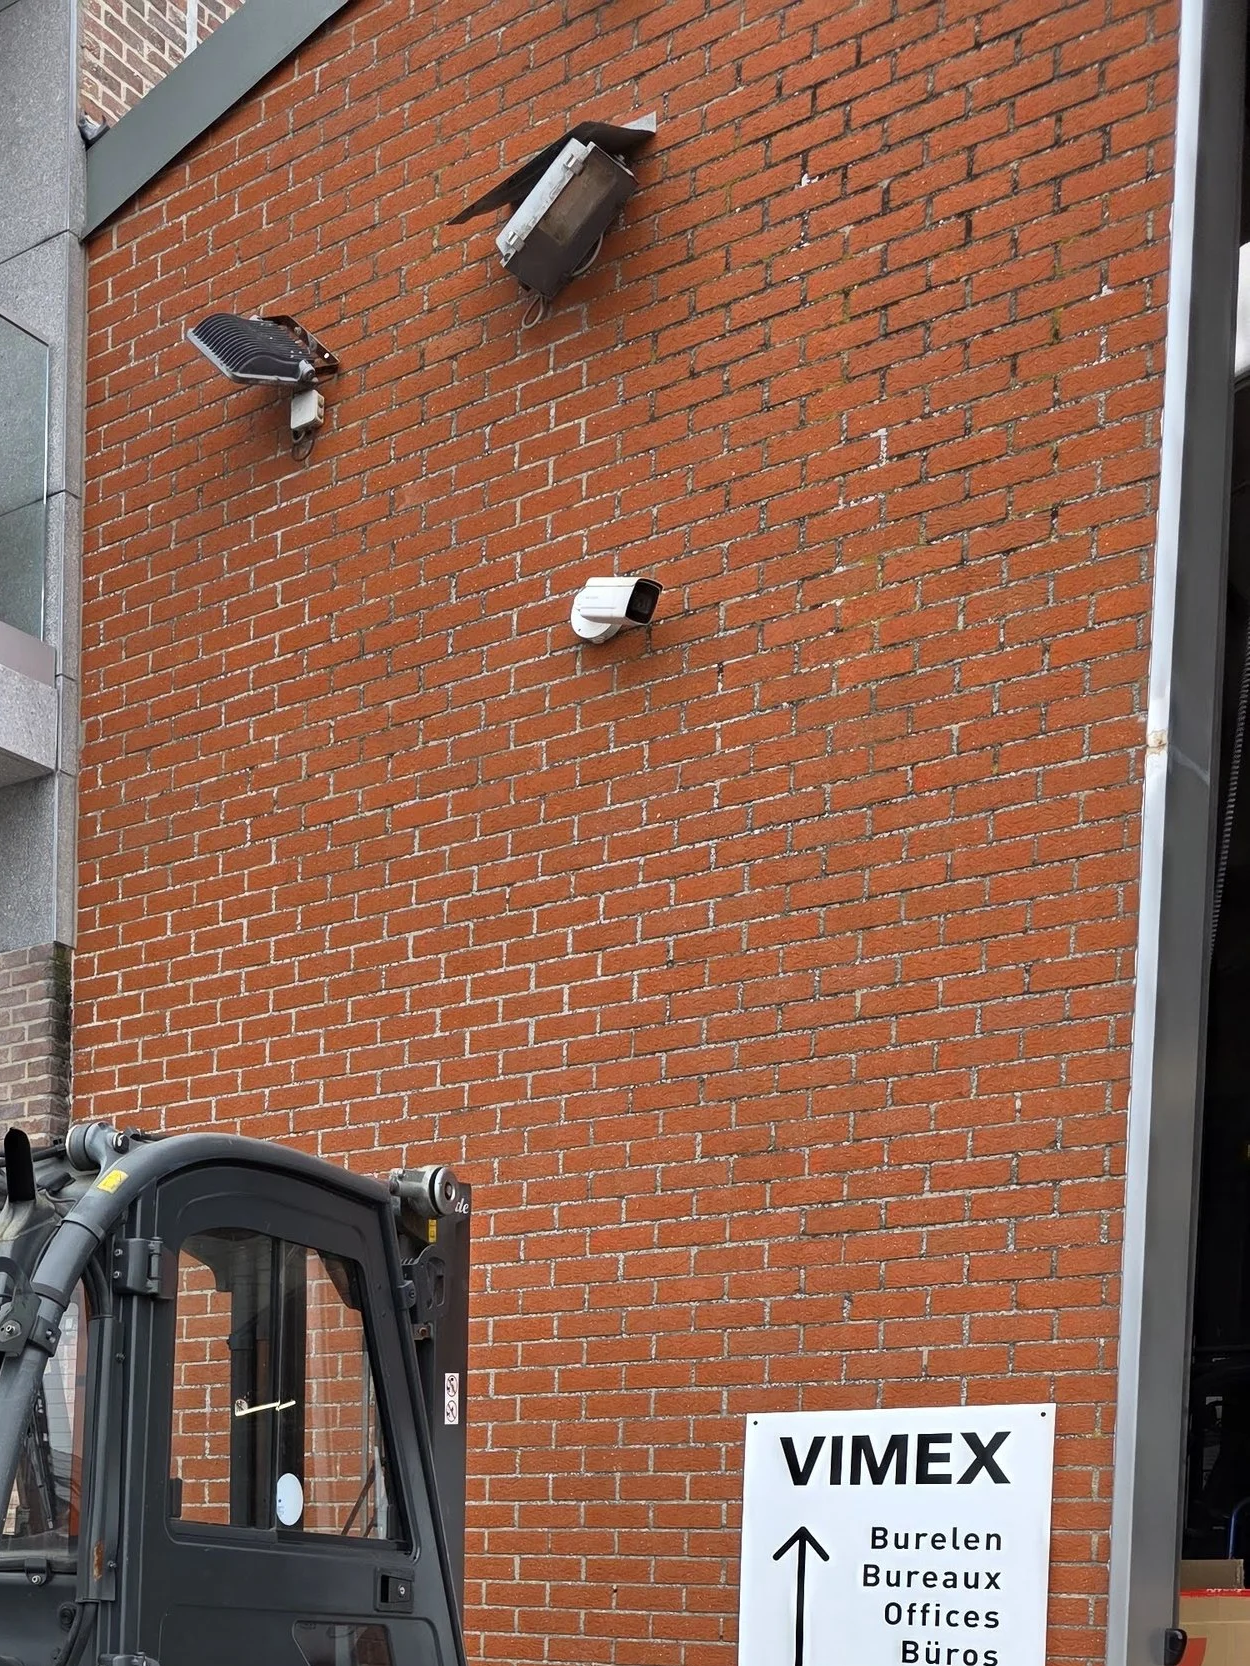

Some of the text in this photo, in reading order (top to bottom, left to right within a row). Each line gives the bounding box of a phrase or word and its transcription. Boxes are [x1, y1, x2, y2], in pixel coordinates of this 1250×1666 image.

[779, 1431, 1012, 1486] VIMEX
[870, 1526, 1002, 1551] Burelen
[862, 1564, 1001, 1590] Bureaux
[884, 1602, 1000, 1629] Offices
